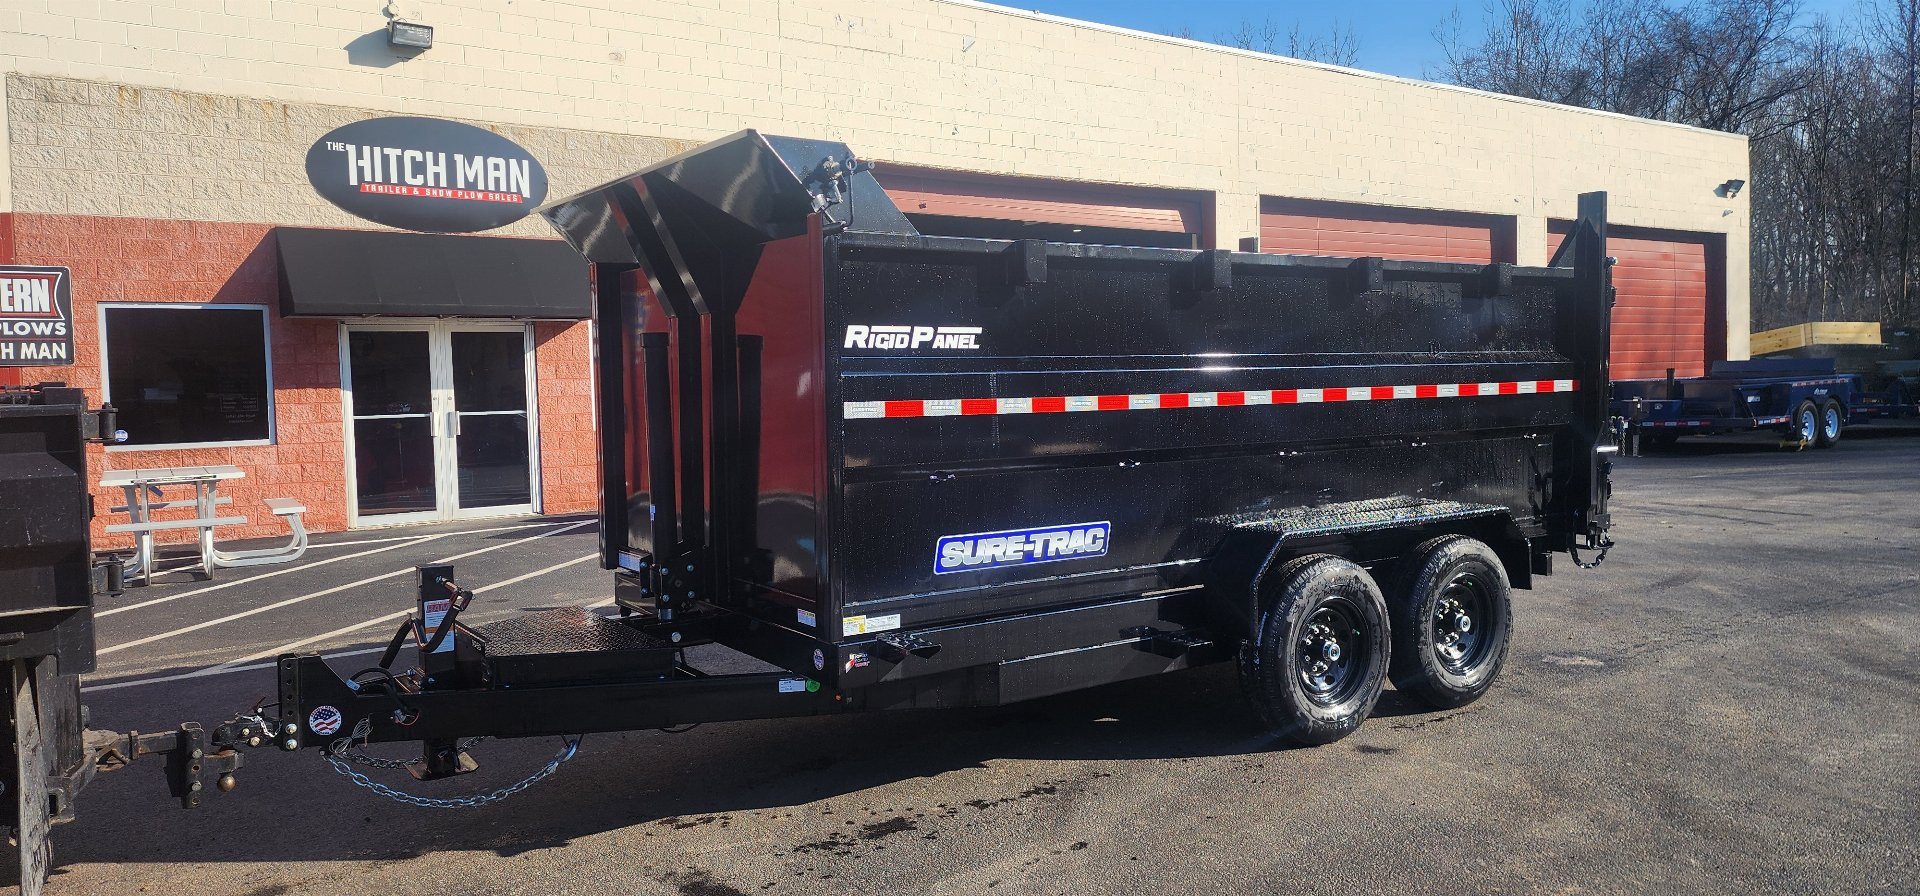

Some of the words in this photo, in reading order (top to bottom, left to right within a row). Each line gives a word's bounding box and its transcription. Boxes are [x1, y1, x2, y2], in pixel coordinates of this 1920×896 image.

[326, 141, 345, 151] THE
[346, 144, 447, 188] HITCH
[454, 153, 531, 198] MAN
[365, 184, 407, 194] TRAILER
[425, 189, 452, 197] SNOW
[458, 191, 483, 199] PLOW
[488, 193, 518, 202] SALES
[0, 322, 66, 335] LOWS
[20, 342, 67, 359] MAN
[940, 527, 1105, 567] SURE-TRAC
